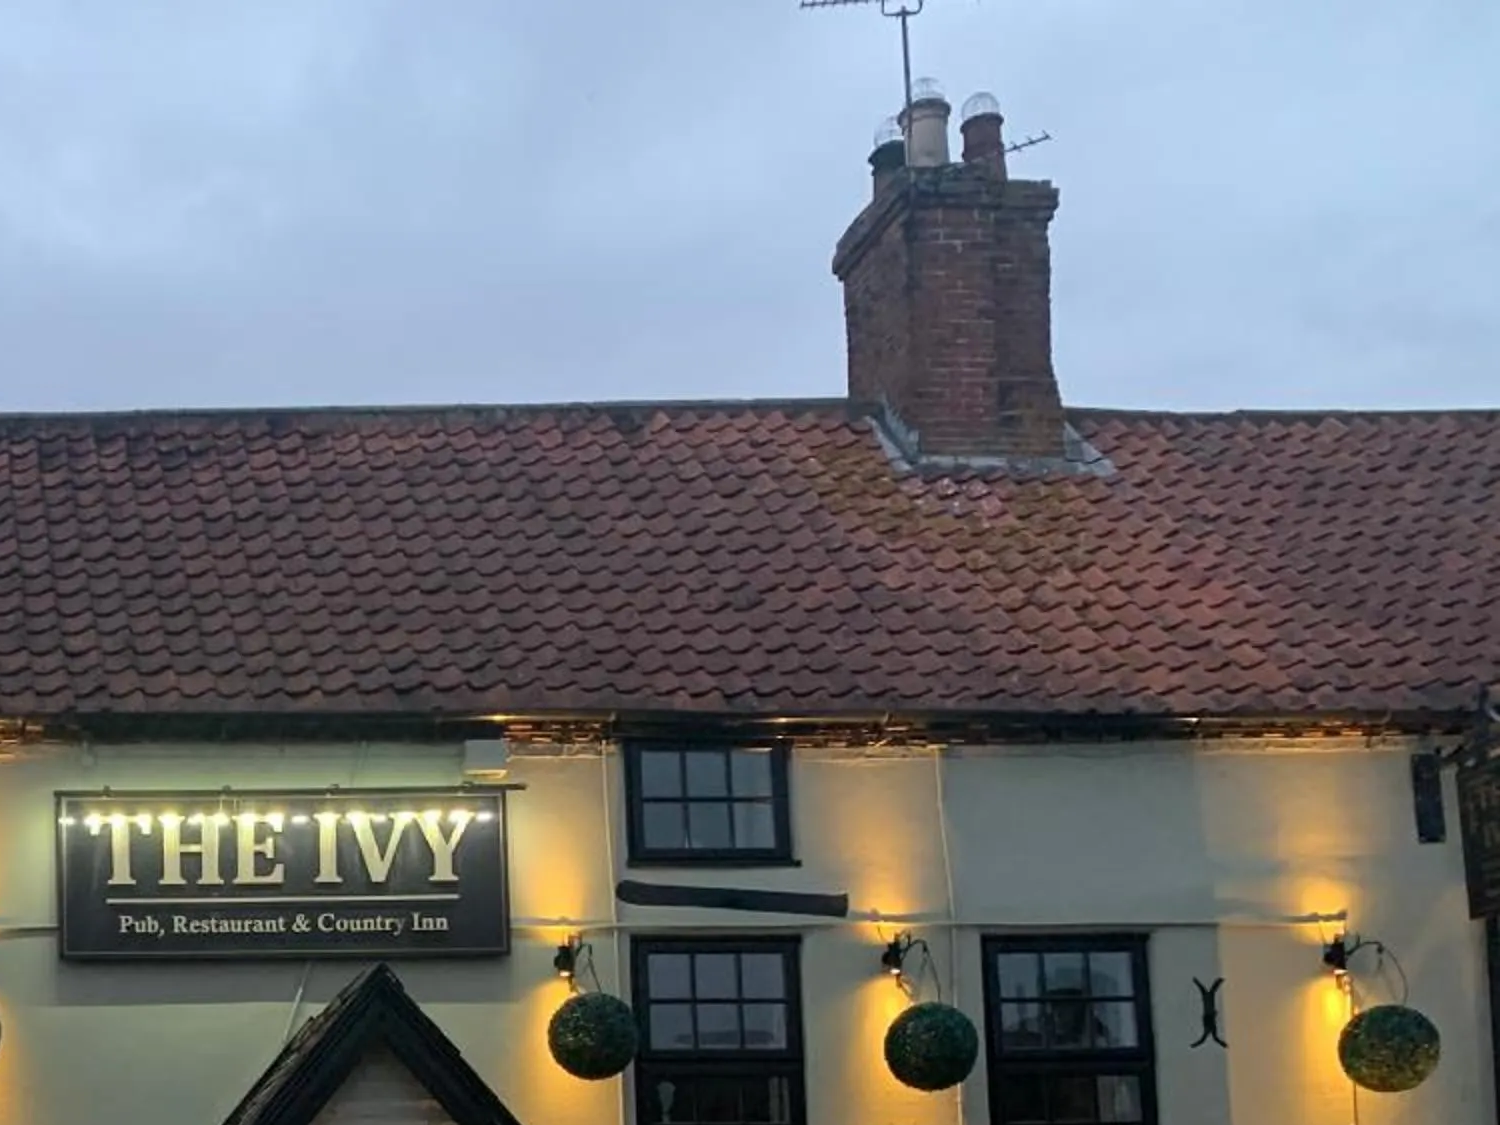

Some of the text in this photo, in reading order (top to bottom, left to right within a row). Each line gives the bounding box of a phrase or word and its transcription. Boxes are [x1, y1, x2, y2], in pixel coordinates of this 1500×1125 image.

[86, 810, 474, 886] THE IVY
[118, 911, 449, 936] Pub, Restaurant & Country Inn
